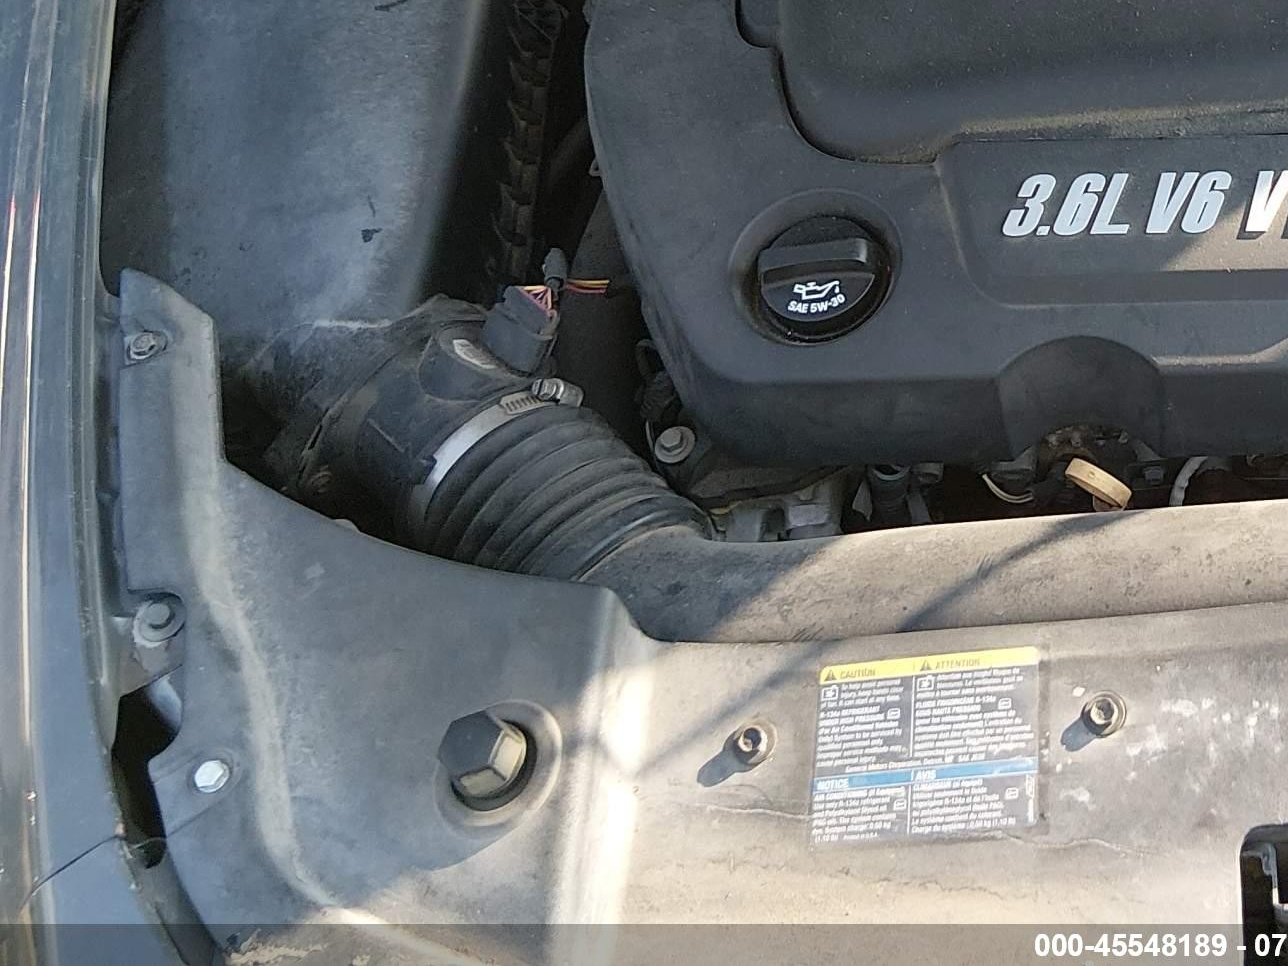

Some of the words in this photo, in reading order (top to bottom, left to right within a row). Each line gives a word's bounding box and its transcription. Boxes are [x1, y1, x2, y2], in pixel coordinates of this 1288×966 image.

[1001, 172, 1131, 237] 3.6L
[1145, 170, 1233, 234] V6
[787, 300, 809, 314] SAE
[809, 293, 846, 314] 5W-30
[935, 657, 980, 669] ATTENTION
[839, 667, 875, 679] CAUTION
[914, 769, 936, 780] AVIS
[816, 778, 848, 790] NOTICE
